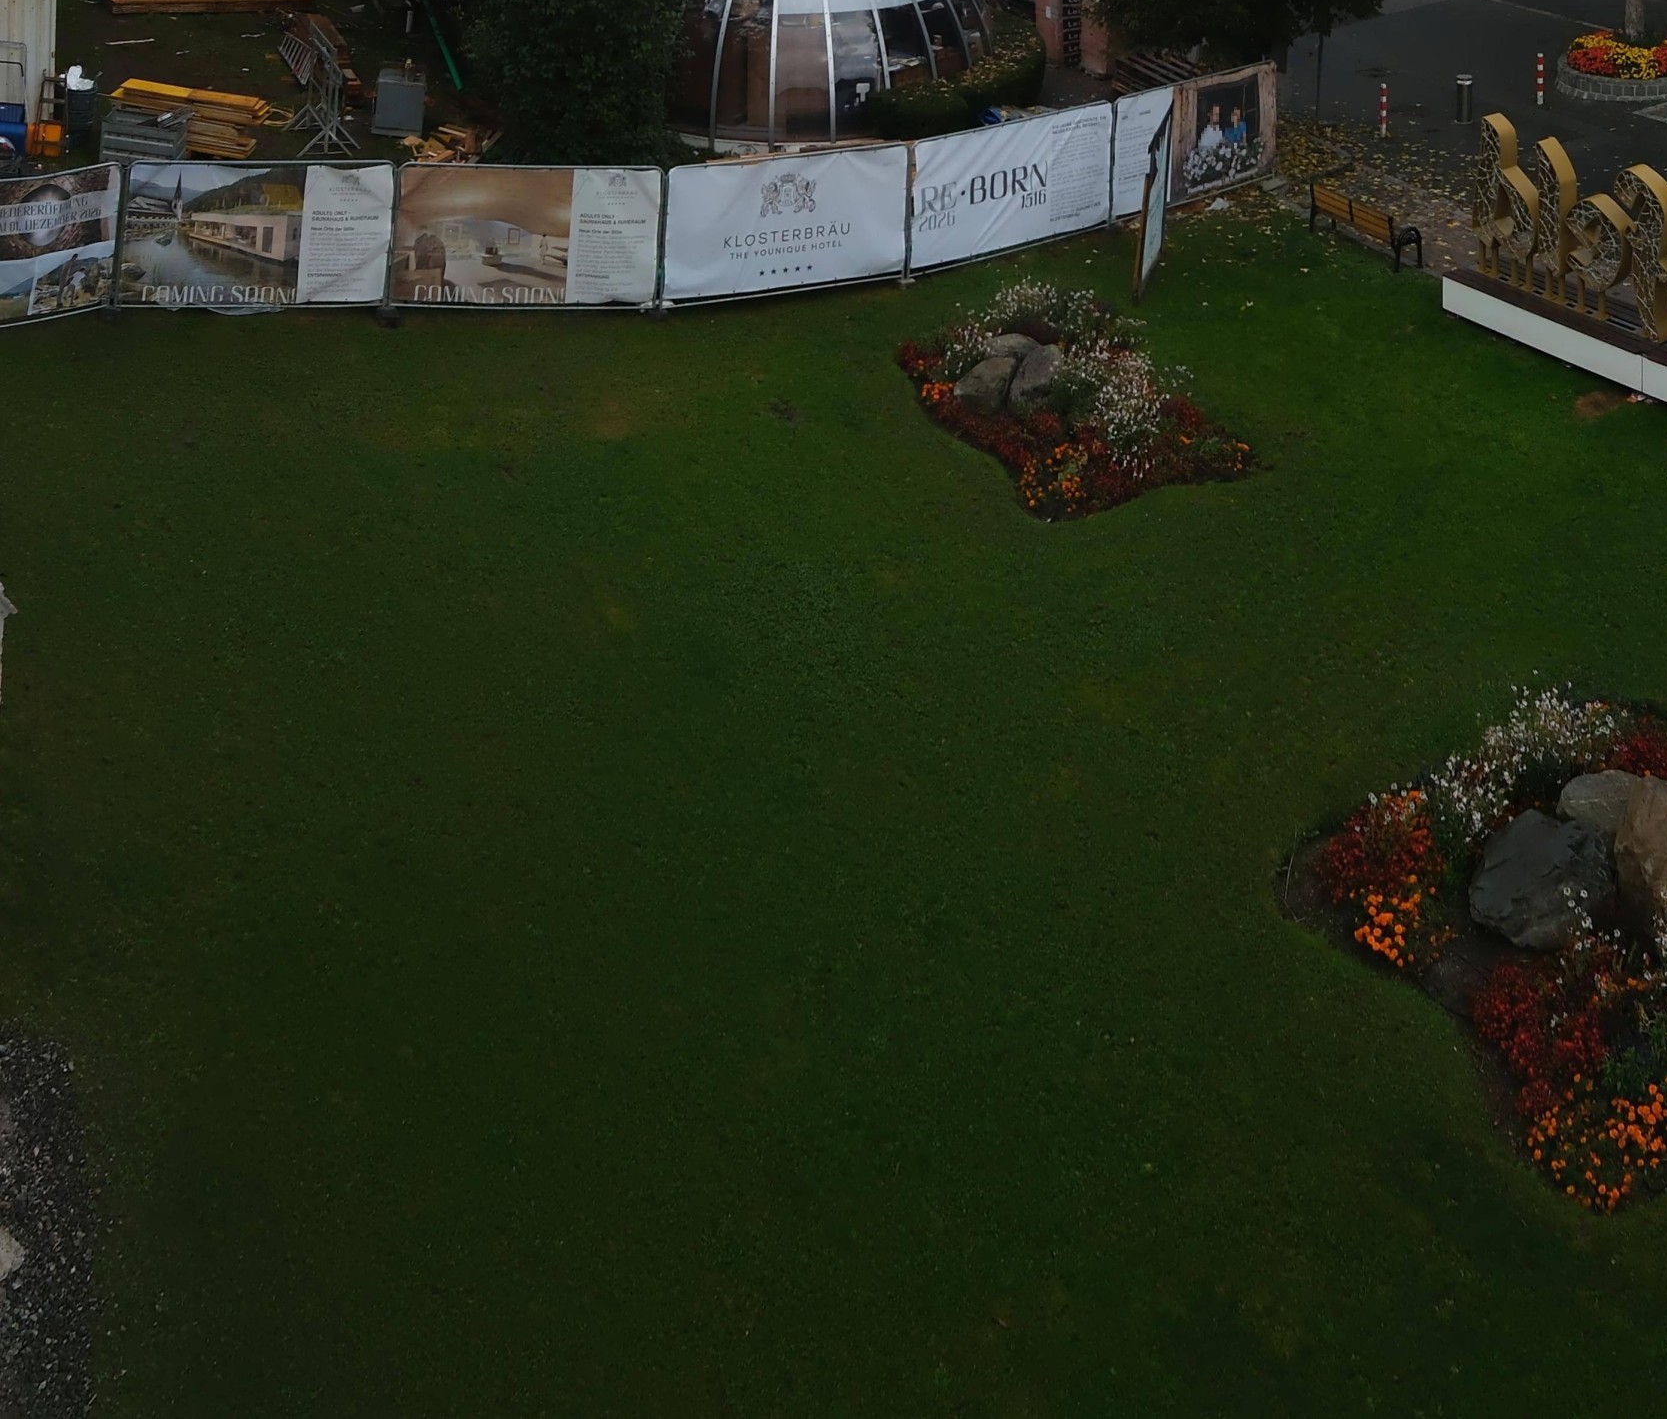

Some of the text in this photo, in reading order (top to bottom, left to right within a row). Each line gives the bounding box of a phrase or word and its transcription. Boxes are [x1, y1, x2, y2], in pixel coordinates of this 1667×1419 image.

[1021, 188, 1047, 210] 1516
[919, 210, 956, 232] 2026
[723, 221, 850, 249] KLOSTERBRÄU
[730, 240, 842, 260] THE YOUNIQUE HOTEL
